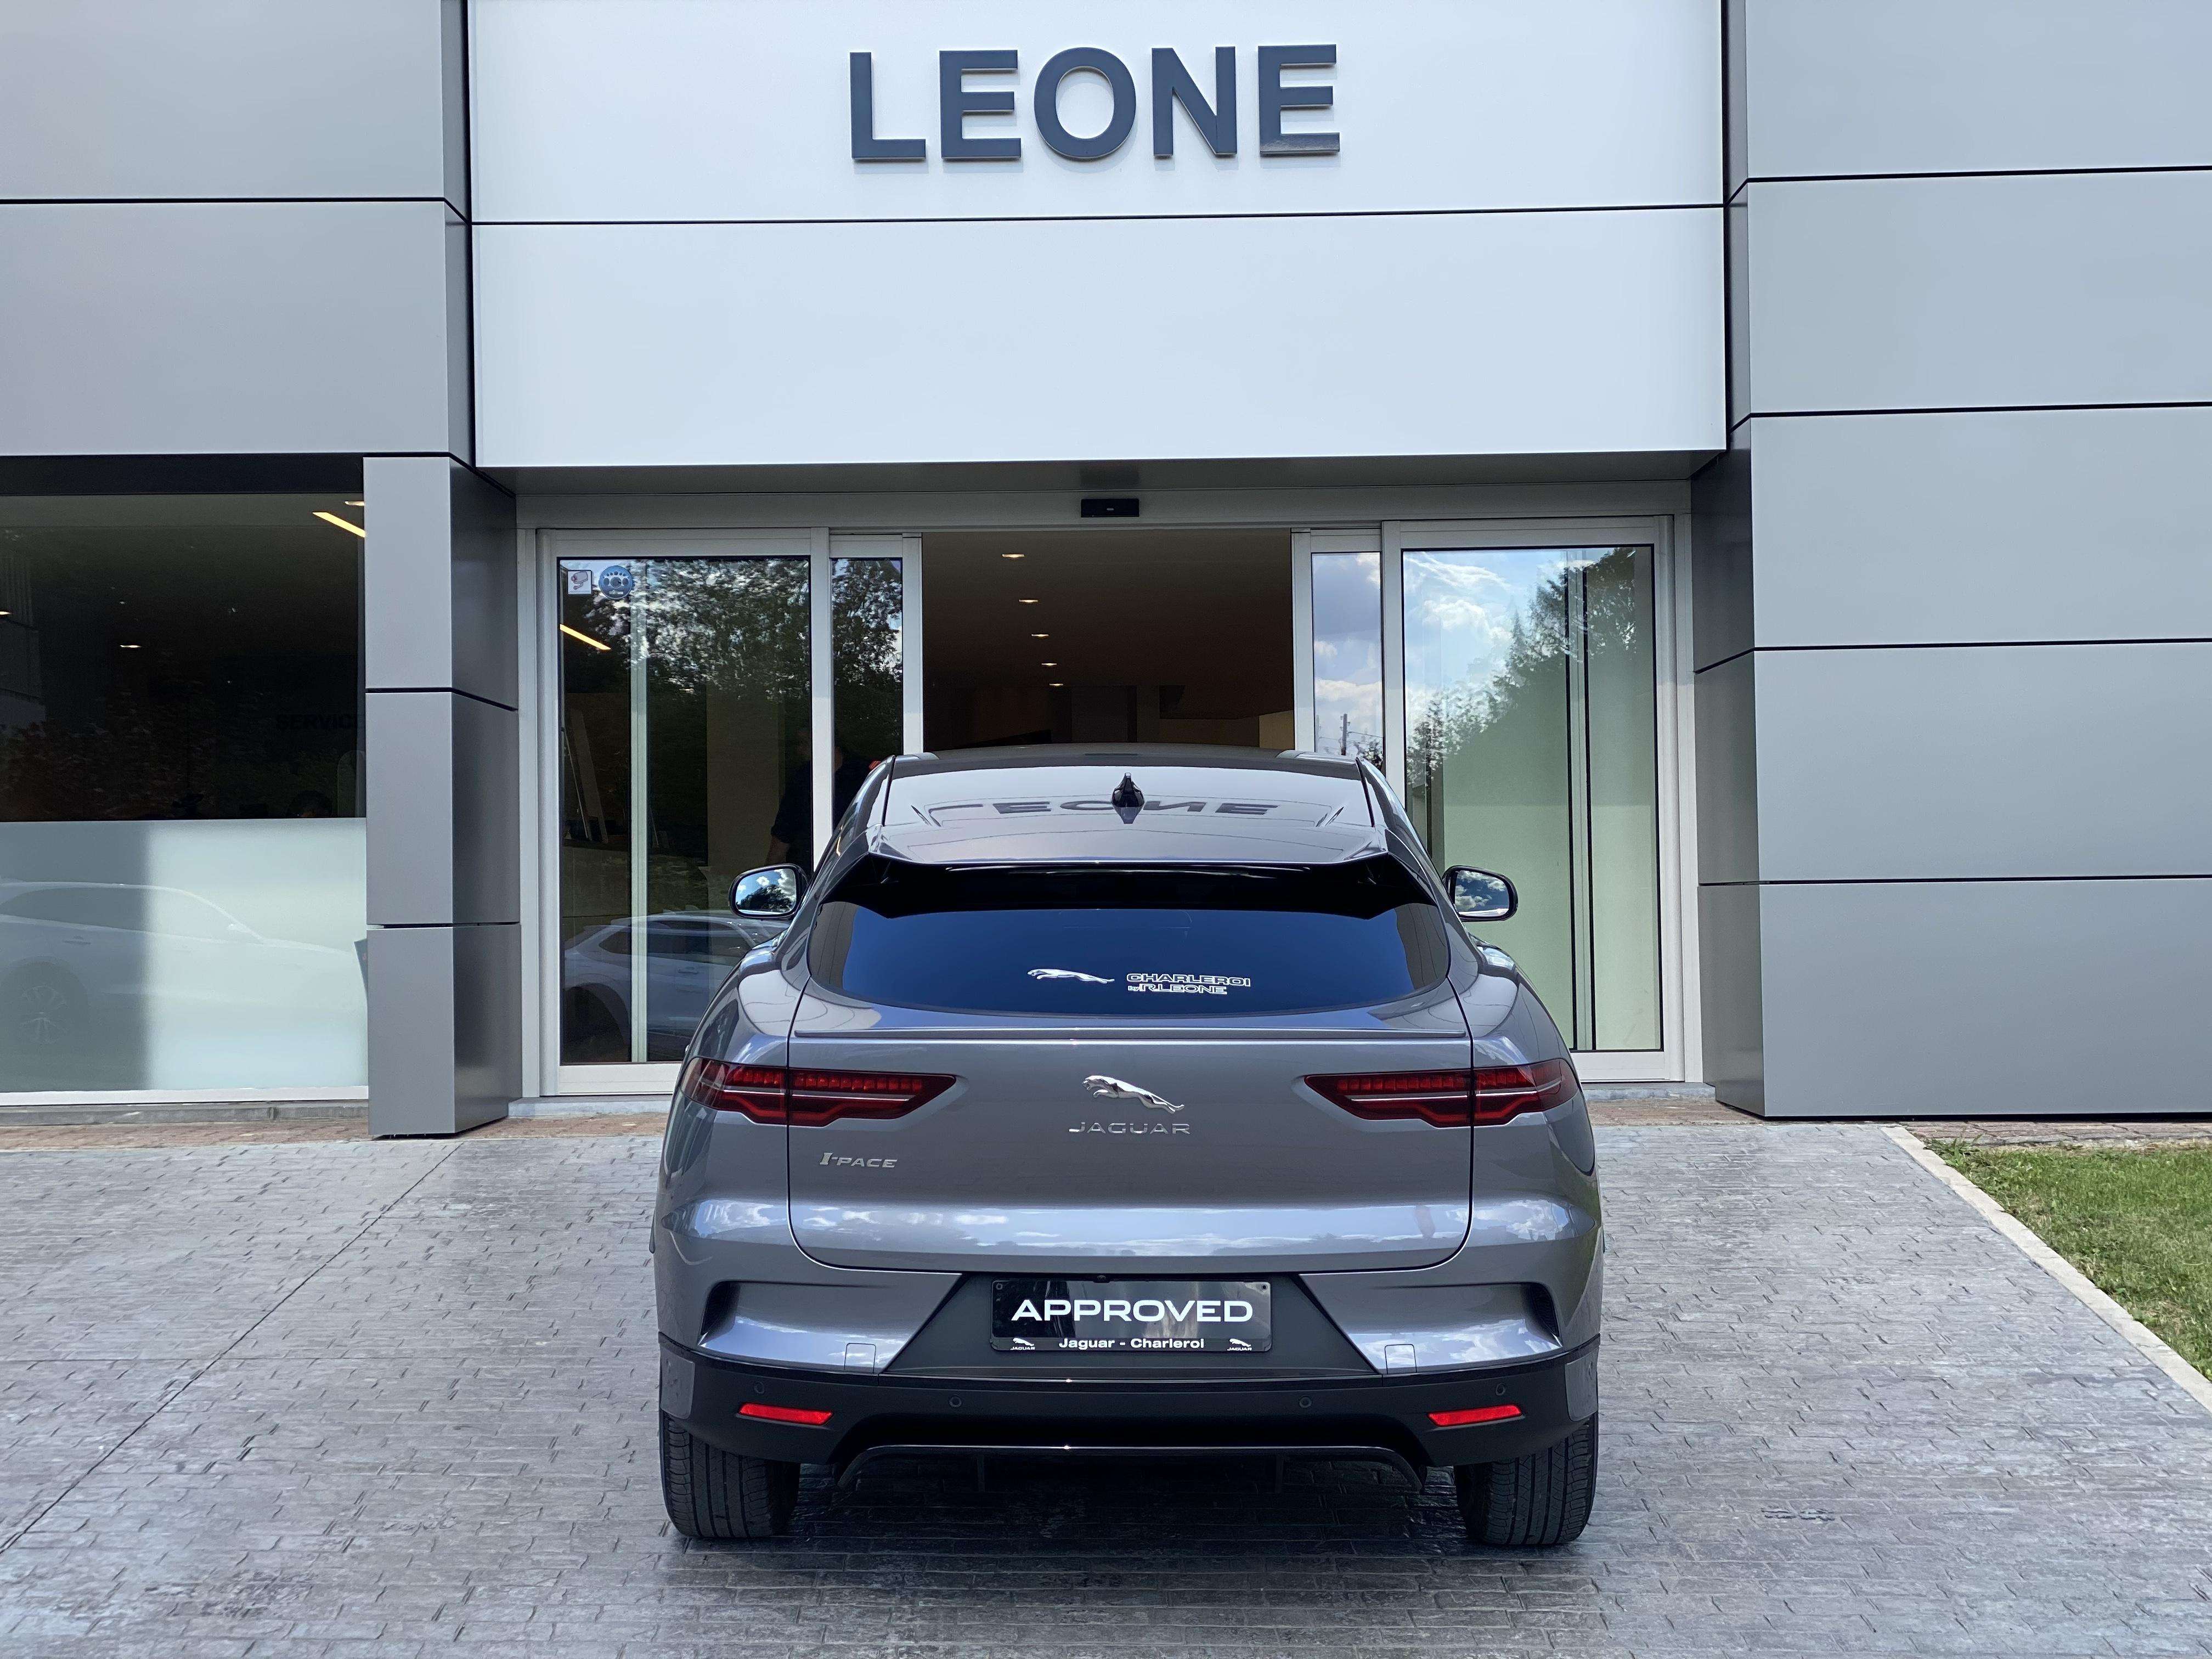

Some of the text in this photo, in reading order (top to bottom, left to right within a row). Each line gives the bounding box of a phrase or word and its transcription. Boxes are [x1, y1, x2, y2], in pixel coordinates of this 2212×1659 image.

[849, 44, 1340, 161] LEONE
[276, 714, 359, 730] SERVIC
[1127, 973, 1251, 986] CHARLEROI
[1069, 1122, 1190, 1134] JAGUAR
[820, 1153, 897, 1168] I-PACE
[1011, 1299, 1253, 1322] APPROVED
[1059, 1338, 1115, 1350] Jaguar
[1130, 1338, 1204, 1348] Charleroi
